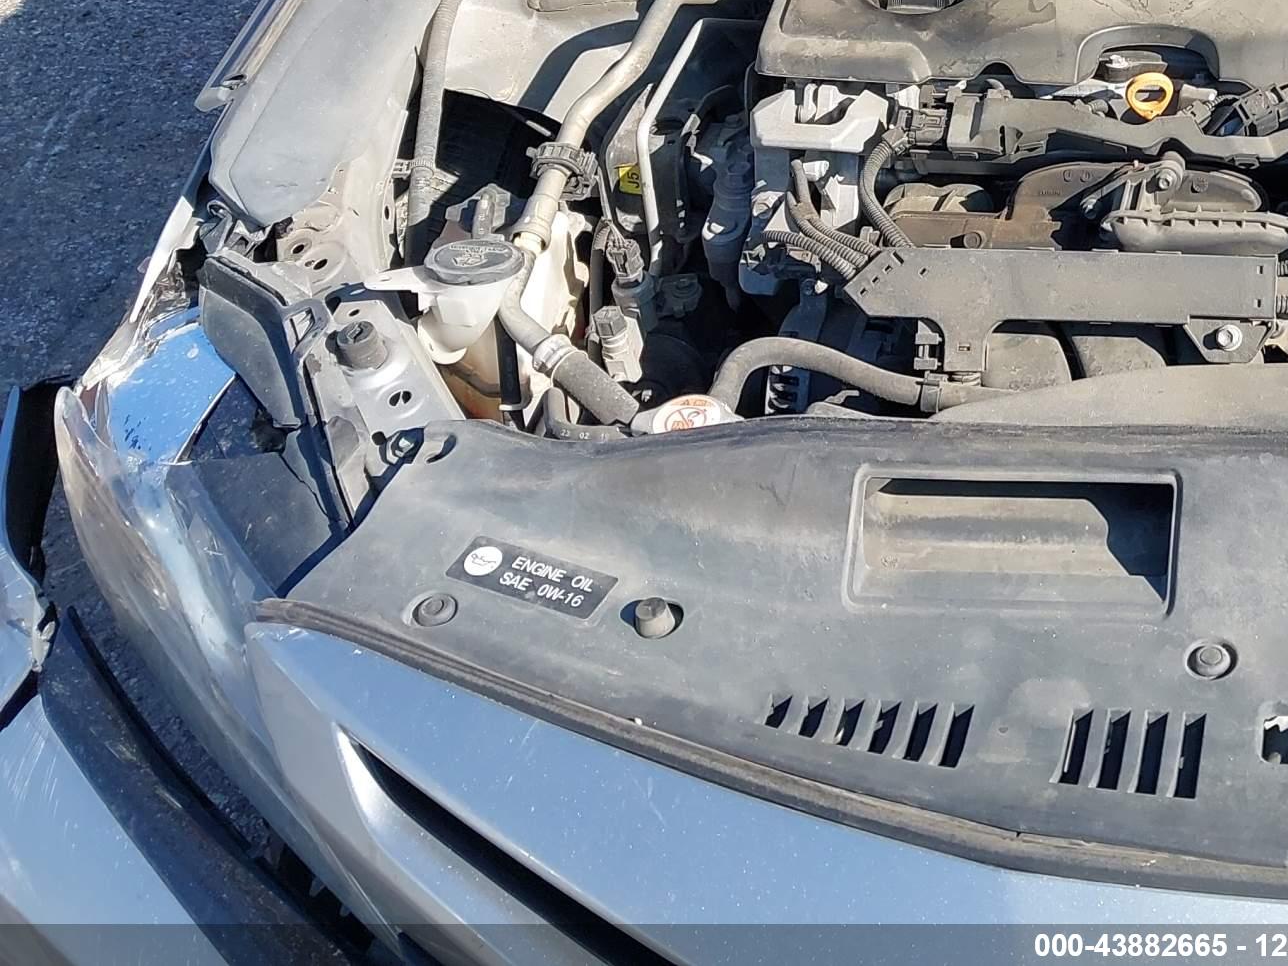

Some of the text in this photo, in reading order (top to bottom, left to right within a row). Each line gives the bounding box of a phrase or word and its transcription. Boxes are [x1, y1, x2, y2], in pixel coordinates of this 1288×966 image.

[627, 172, 640, 189] J5
[500, 572, 584, 608] SAE 0W-16
[511, 556, 595, 592] ENGINE OIL
